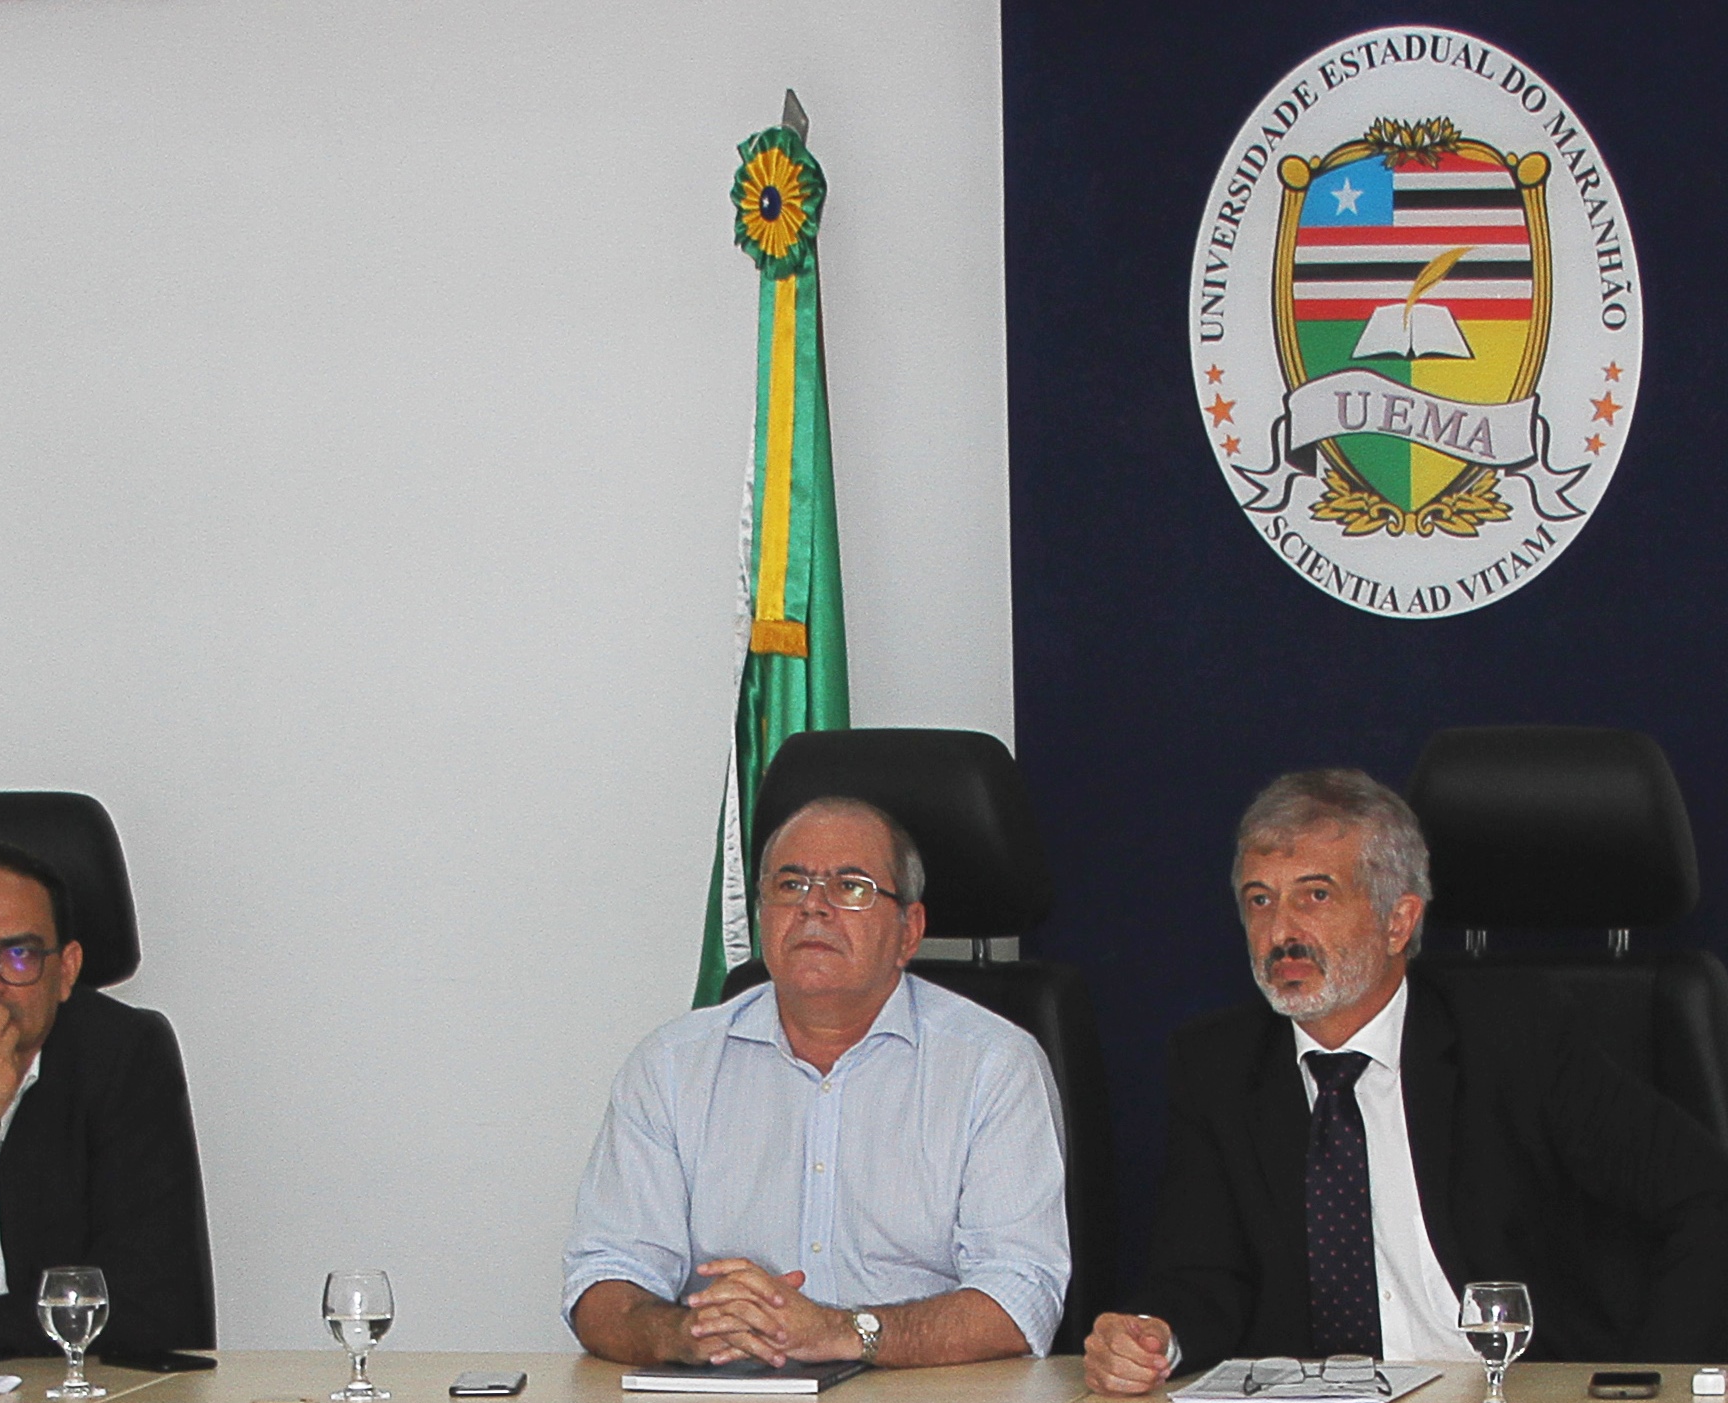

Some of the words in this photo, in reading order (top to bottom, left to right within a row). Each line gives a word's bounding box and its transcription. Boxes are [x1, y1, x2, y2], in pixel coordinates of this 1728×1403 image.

[1199, 81, 1318, 343] UNIVERSIDADE
[1319, 33, 1495, 90] ESTADUAL
[1499, 63, 1547, 113] DO
[1544, 109, 1632, 332] MARANHÃO
[1333, 390, 1497, 459] UEMA
[1264, 515, 1401, 613] SCIENTIA
[1406, 583, 1453, 613] AD
[1456, 523, 1556, 602] VITAM
